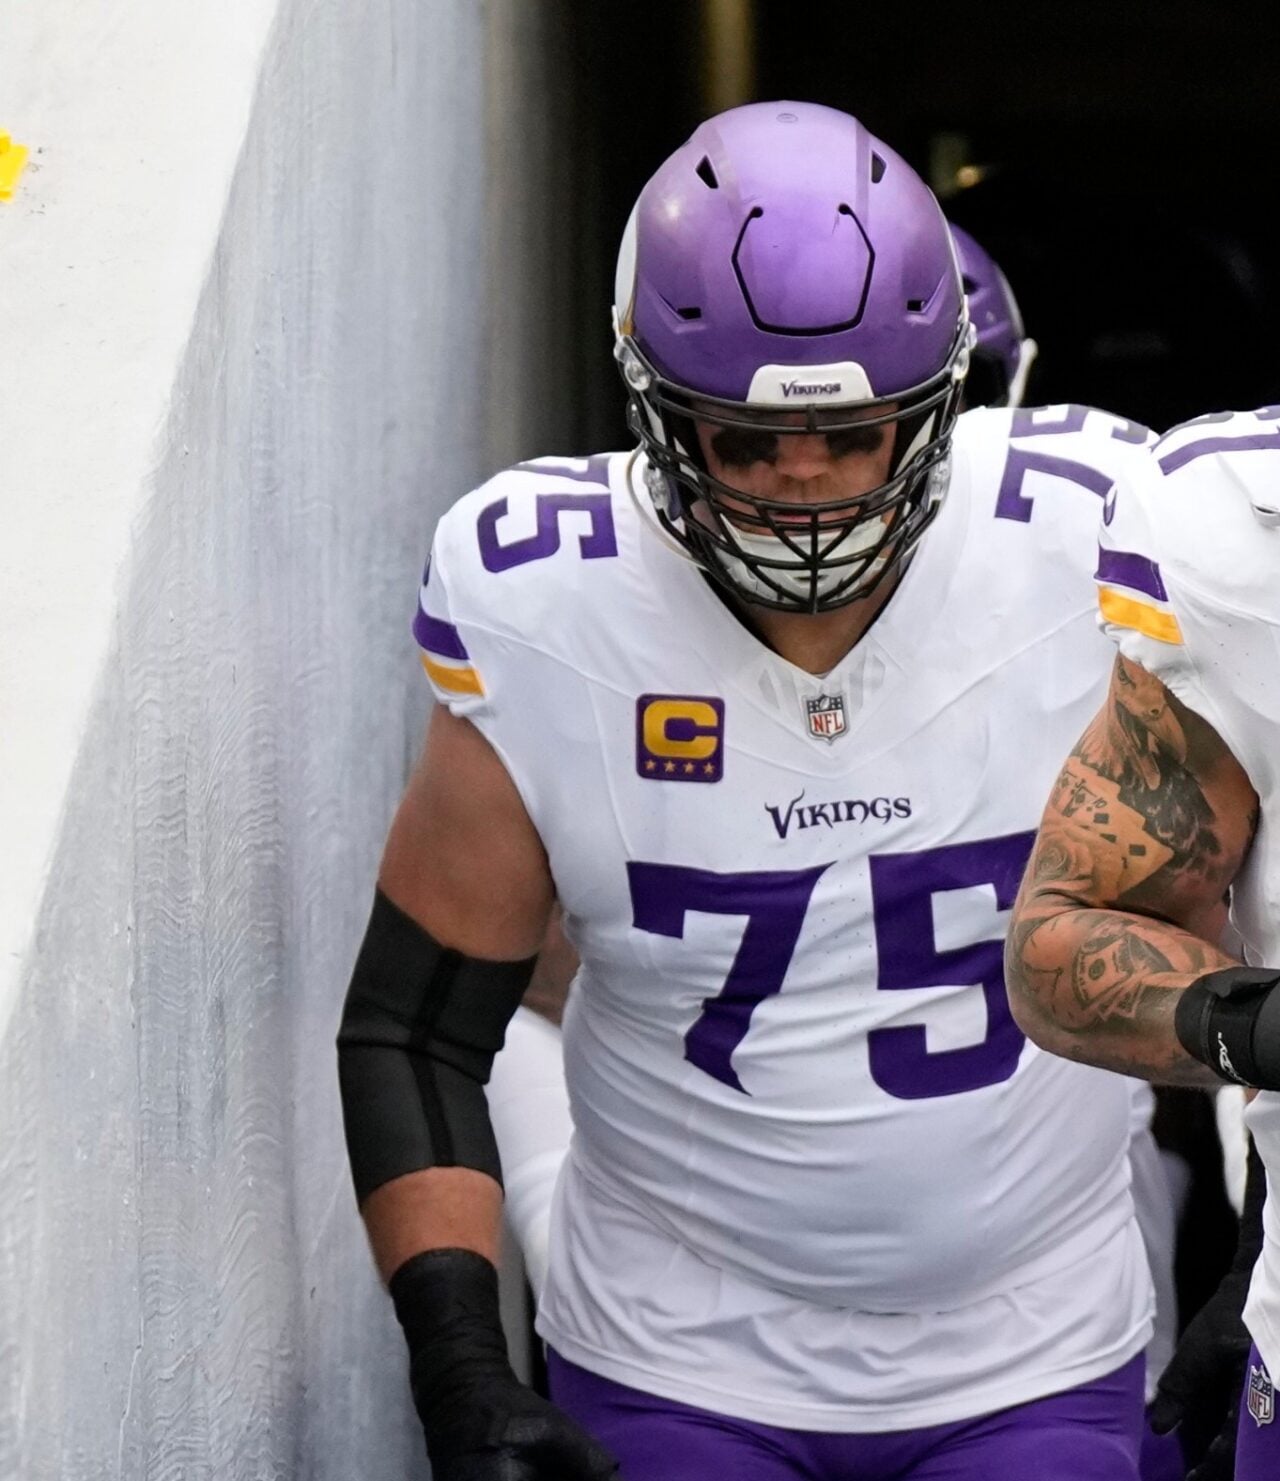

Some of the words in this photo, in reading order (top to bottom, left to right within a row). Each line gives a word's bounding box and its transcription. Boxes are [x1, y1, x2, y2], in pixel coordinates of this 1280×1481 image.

[780, 379, 842, 398] VIKINGS
[643, 699, 719, 760] C
[812, 711, 843, 734] NFL
[764, 788, 912, 840] VIKINGS
[626, 828, 1040, 1101] 75
